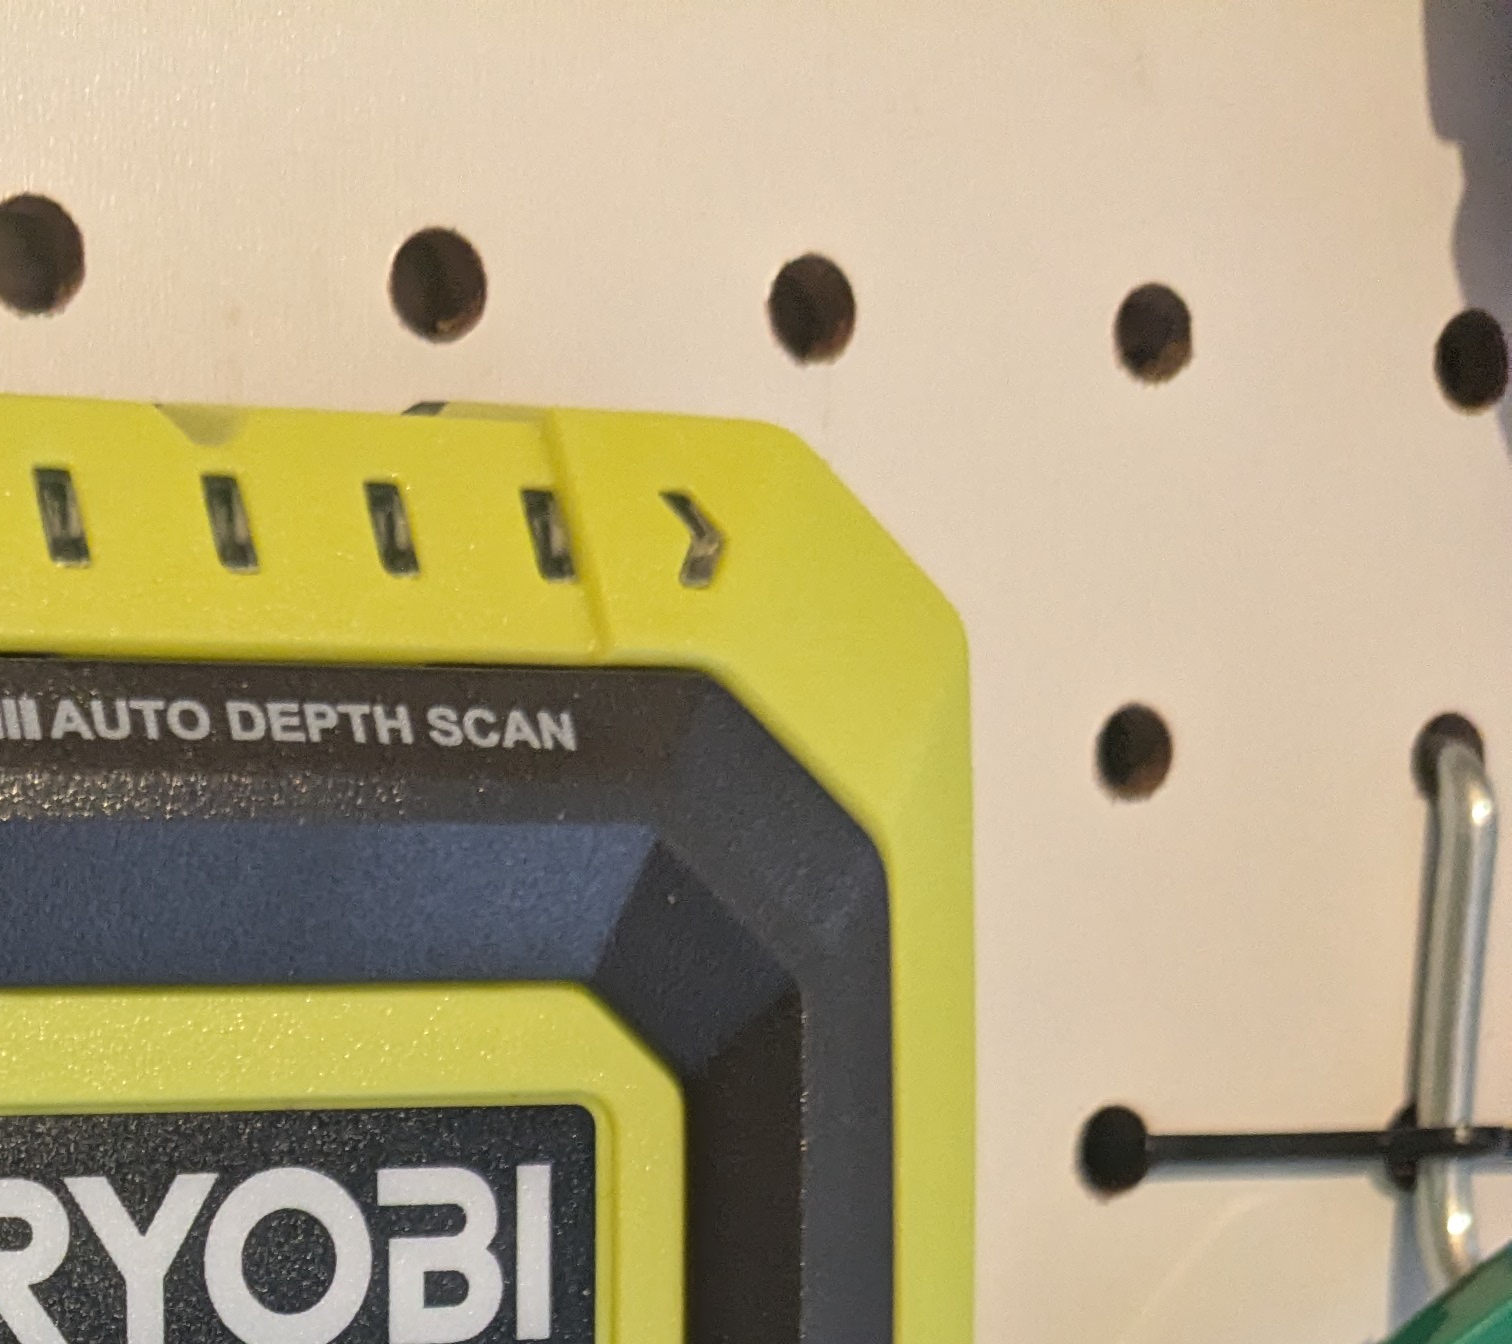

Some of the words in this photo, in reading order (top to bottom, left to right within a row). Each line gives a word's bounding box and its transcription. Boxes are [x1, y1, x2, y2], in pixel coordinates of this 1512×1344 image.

[51, 700, 211, 742] AUTO
[227, 702, 413, 746] DEPTH
[428, 706, 578, 752] SCAN
